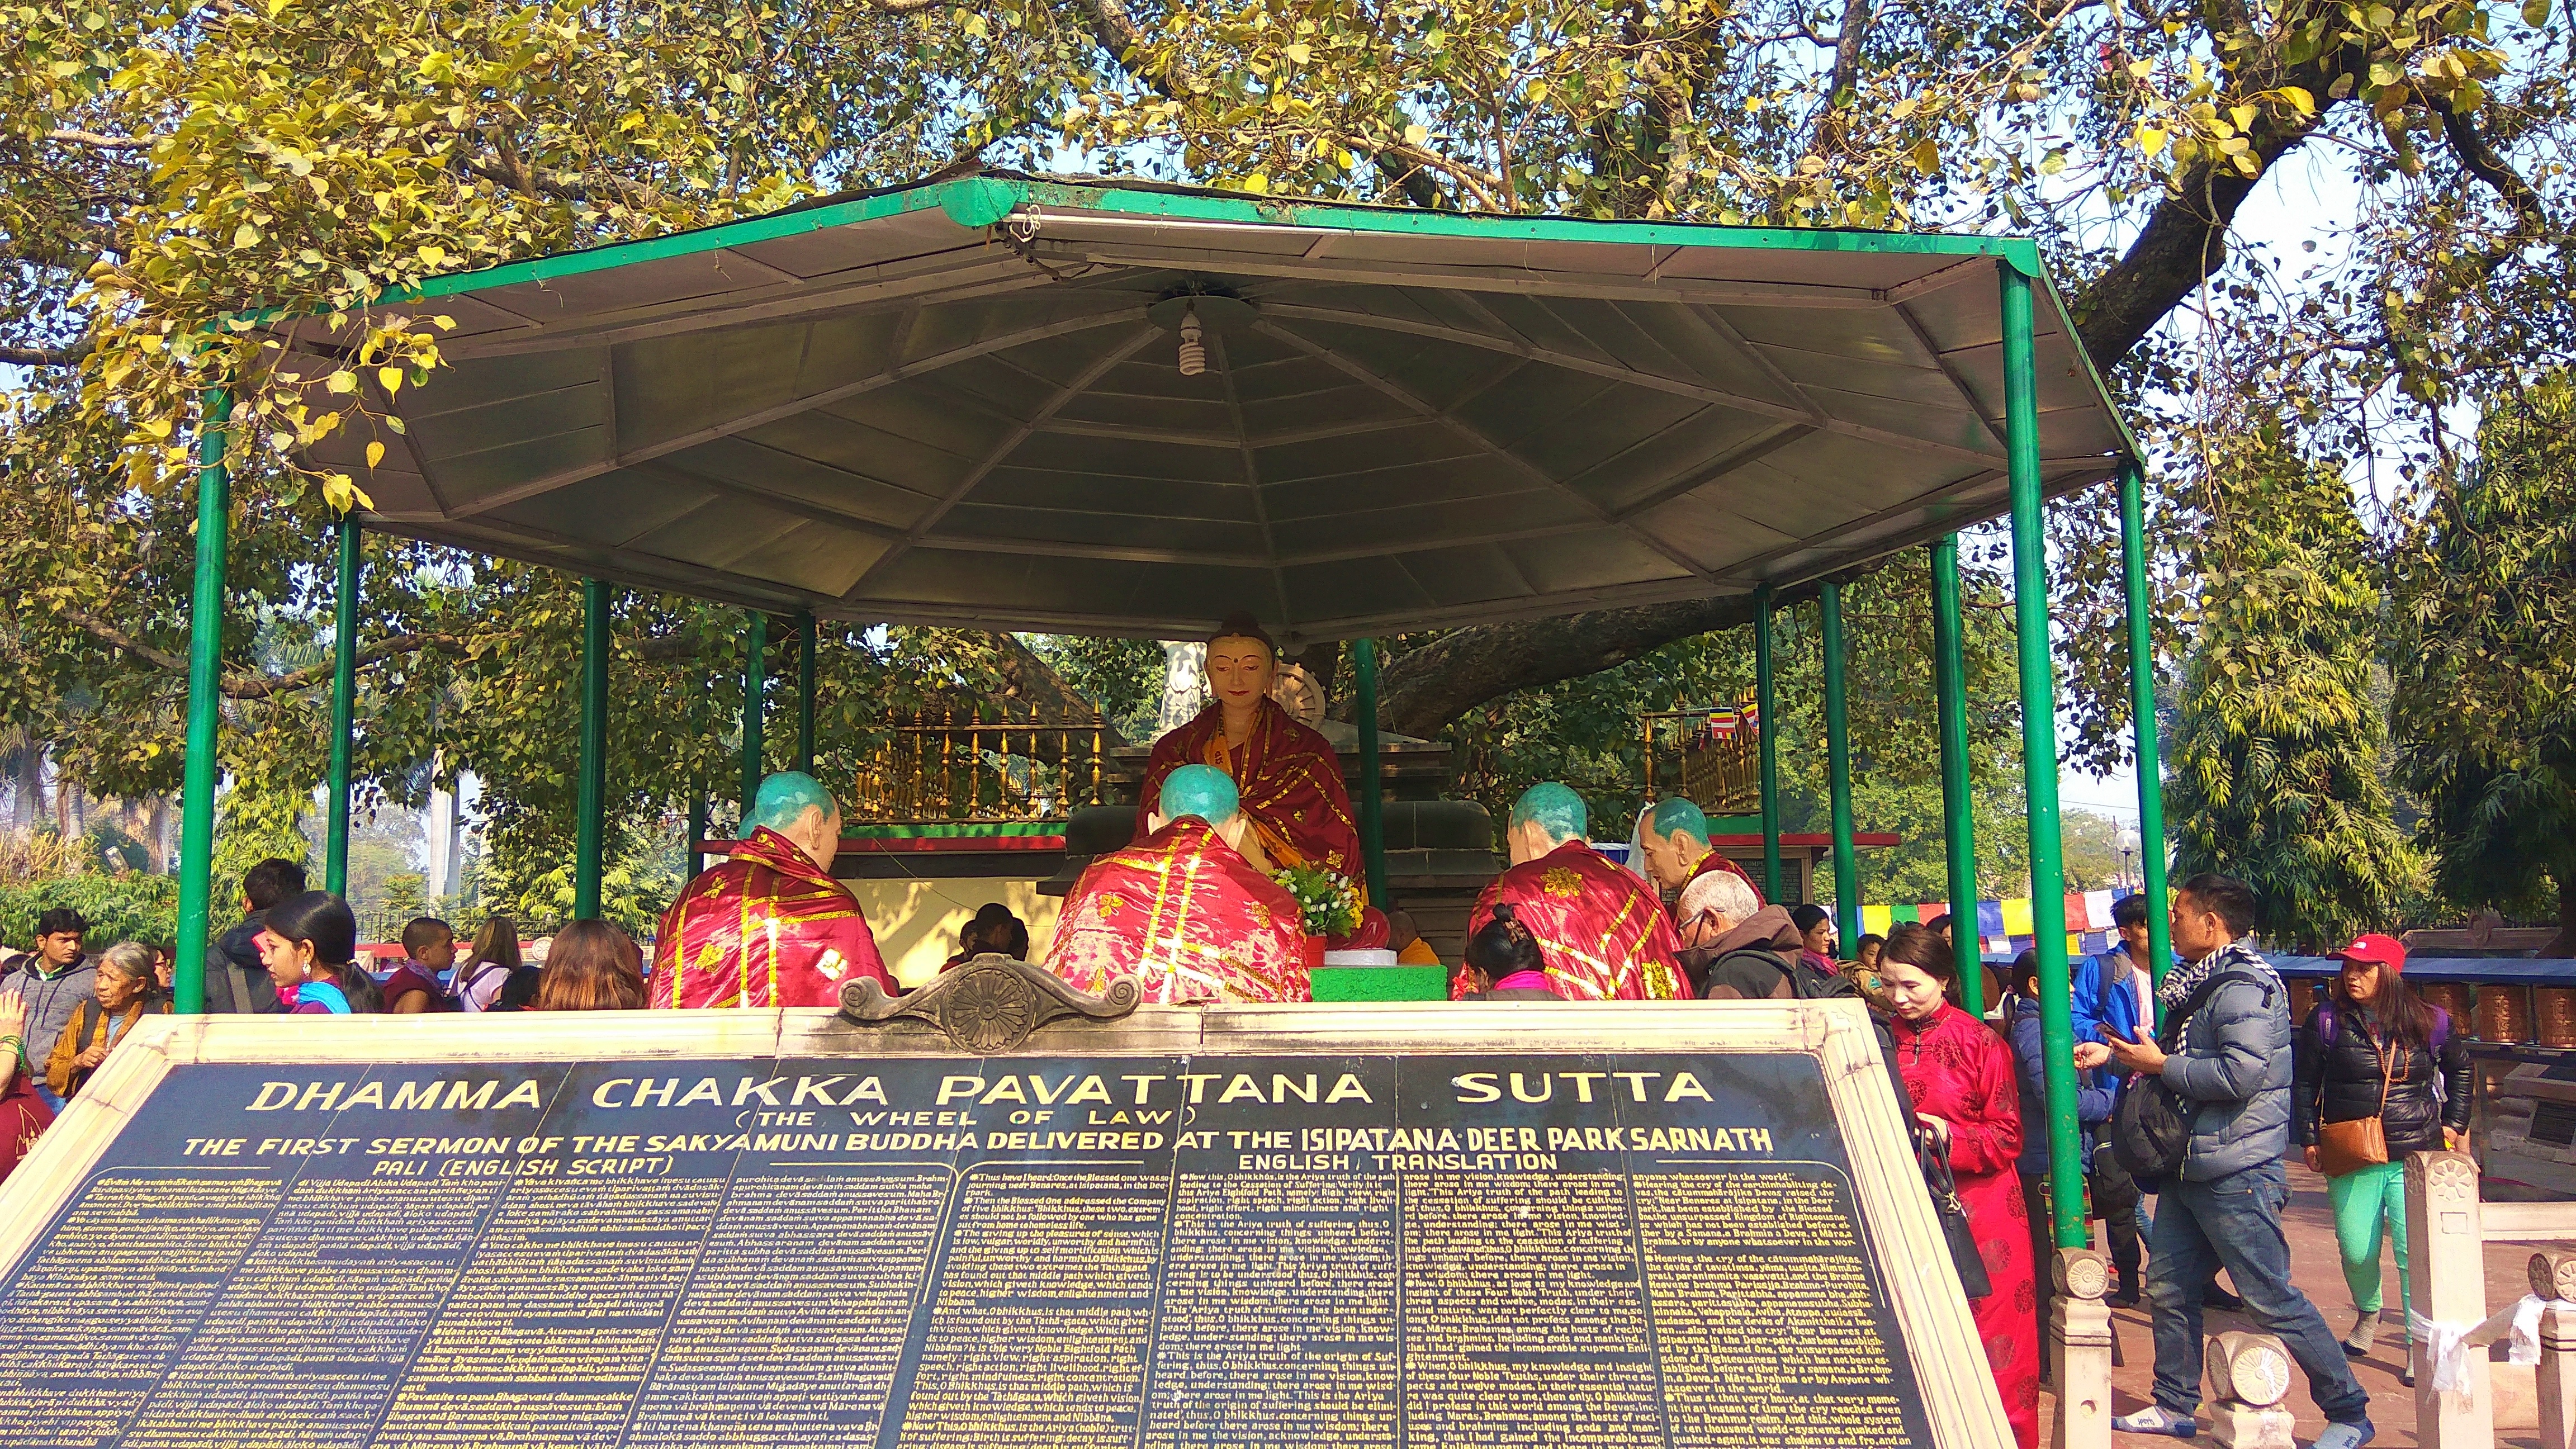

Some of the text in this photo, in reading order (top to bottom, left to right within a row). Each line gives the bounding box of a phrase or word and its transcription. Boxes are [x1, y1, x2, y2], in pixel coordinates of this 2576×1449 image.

[245, 1072, 1714, 1110] DHAMMA CHAKKA PAVATTANA SUTTA
[736, 1106, 1196, 1128] (THE WHEEL OF LAW)
[183, 1127, 1774, 1156] THE FIRST SERMON OF THE SAKYAMUNI BUDDHA DELIVERED AT THE ISIPATANA DEER PARK SARNATH
[372, 1155, 673, 1177] PALI (ENGLISH SCRIPT)
[1239, 1154, 1557, 1171] ENGLISH TRANSLATION
[1632, 1174, 1668, 1182] anyone
[1668, 1172, 1727, 1182] whatsoever
[1728, 1173, 1739, 1182] in
[1740, 1172, 1756, 1181] the
[1404, 1196, 1419, 1205] the
[1422, 1196, 1469, 1205] cessation
[1472, 1196, 1483, 1205] of
[1485, 1196, 1531, 1205] suffering
[1571, 1196, 1583, 1204] be
[1200, 1204, 1223, 1213] right
[1256, 1204, 1279, 1213] right
[1363, 1204, 1389, 1213] right
[1027, 1213, 1067, 1221] followed
[1068, 1213, 1079, 1221] by
[1223, 1228, 1276, 1238] concerning
[1281, 1228, 1312, 1238] things
[1318, 1228, 1356, 1238] unheard
[945, 1262, 987, 1272] avoiding
[988, 1262, 1014, 1271] these
[489, 1336, 543, 1346] Bhagavato
[1425, 1333, 1443, 1342] and
[1497, 1334, 1545, 1343] including
[1547, 1334, 1570, 1343] gods
[1574, 1334, 1592, 1343] and
[978, 1343, 987, 1354] is
[989, 1343, 1008, 1354] this
[1009, 1345, 1034, 1353] very
[1034, 1344, 1062, 1354] Noble
[1063, 1343, 1110, 1354] Eightfold
[1113, 1343, 1136, 1353] Path
[963, 1352, 992, 1363] right
[1022, 1353, 1052, 1363] right
[1111, 1354, 1138, 1363] right
[1167, 1351, 1190, 1360] This
[1194, 1351, 1203, 1360] is
[1206, 1351, 1221, 1360] the
[1225, 1351, 1256, 1362] Ariya
[1258, 1351, 1287, 1361] truth
[1291, 1352, 1301, 1361] of
[1304, 1352, 1322, 1361] the
[1324, 1352, 1358, 1362] origin
[1361, 1352, 1373, 1361] of
[161, 1380, 216, 1392] bhikkhave
[215, 1381, 249, 1392] pubbe
[332, 1381, 391, 1391] dhammesu
[1406, 1382, 1436, 1391] pects
[1439, 1381, 1459, 1390] and
[1461, 1381, 1495, 1391] twelve
[1537, 1381, 1548, 1391] in
[1550, 1381, 1576, 1391] their
[1578, 1382, 1626, 1391] essential
[1680, 1403, 1691, 1415] in
[1693, 1405, 1707, 1415] an
[1708, 1403, 1746, 1415] instant
[1749, 1403, 1760, 1414] of
[1761, 1403, 1787, 1413] time
[1788, 1403, 1807, 1415] the
[1810, 1405, 1829, 1415] cry
[1830, 1403, 1874, 1414] reached
[1876, 1406, 1901, 1414] even
[1668, 1414, 1680, 1425] to
[1682, 1413, 1700, 1423] the
[1703, 1413, 1747, 1424] Brahma
[1749, 1414, 1783, 1424] realm.
[1785, 1414, 1806, 1424] And
[1830, 1414, 1862, 1424] whole
[1863, 1416, 1902, 1425] system
[1178, 1431, 1188, 1439] in
[1212, 1431, 1228, 1440] the
